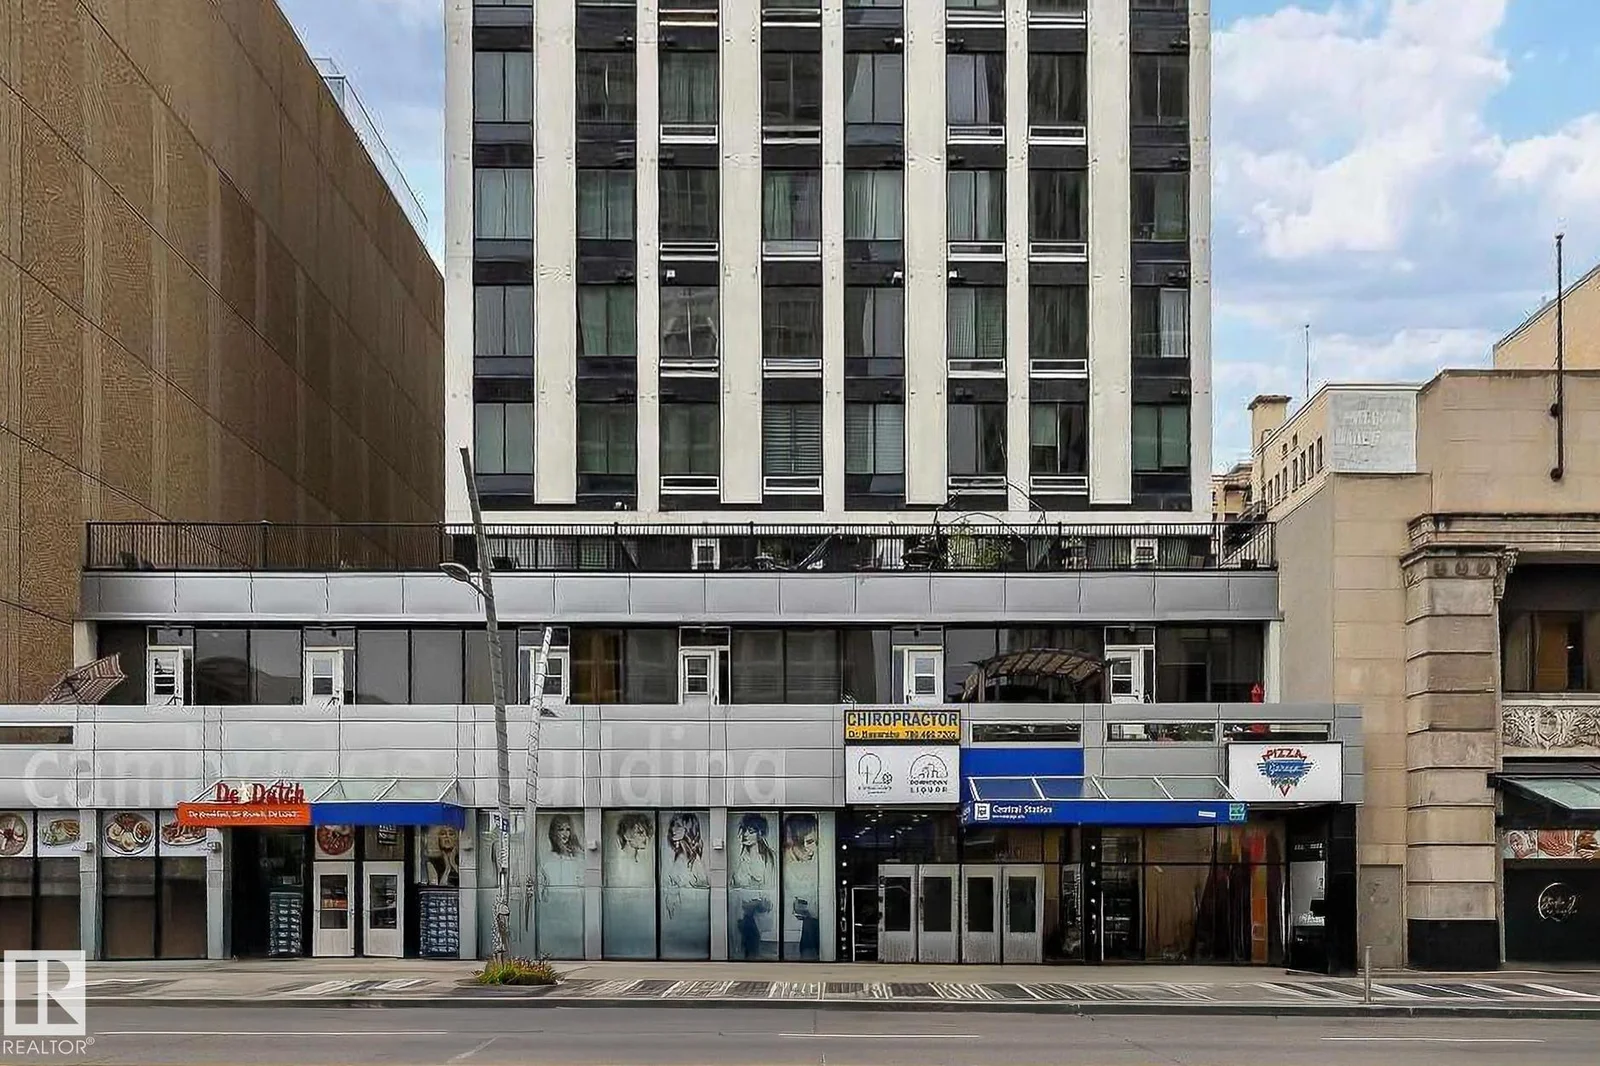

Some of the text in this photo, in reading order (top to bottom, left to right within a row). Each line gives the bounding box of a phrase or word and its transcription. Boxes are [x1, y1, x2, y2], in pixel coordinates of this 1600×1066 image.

[847, 712, 958, 727] CHIROPRACTOR
[1266, 748, 1303, 759] PIZZA
[215, 783, 239, 803] De
[910, 786, 948, 795] LIQUOR
[992, 804, 1053, 814] Central Station
